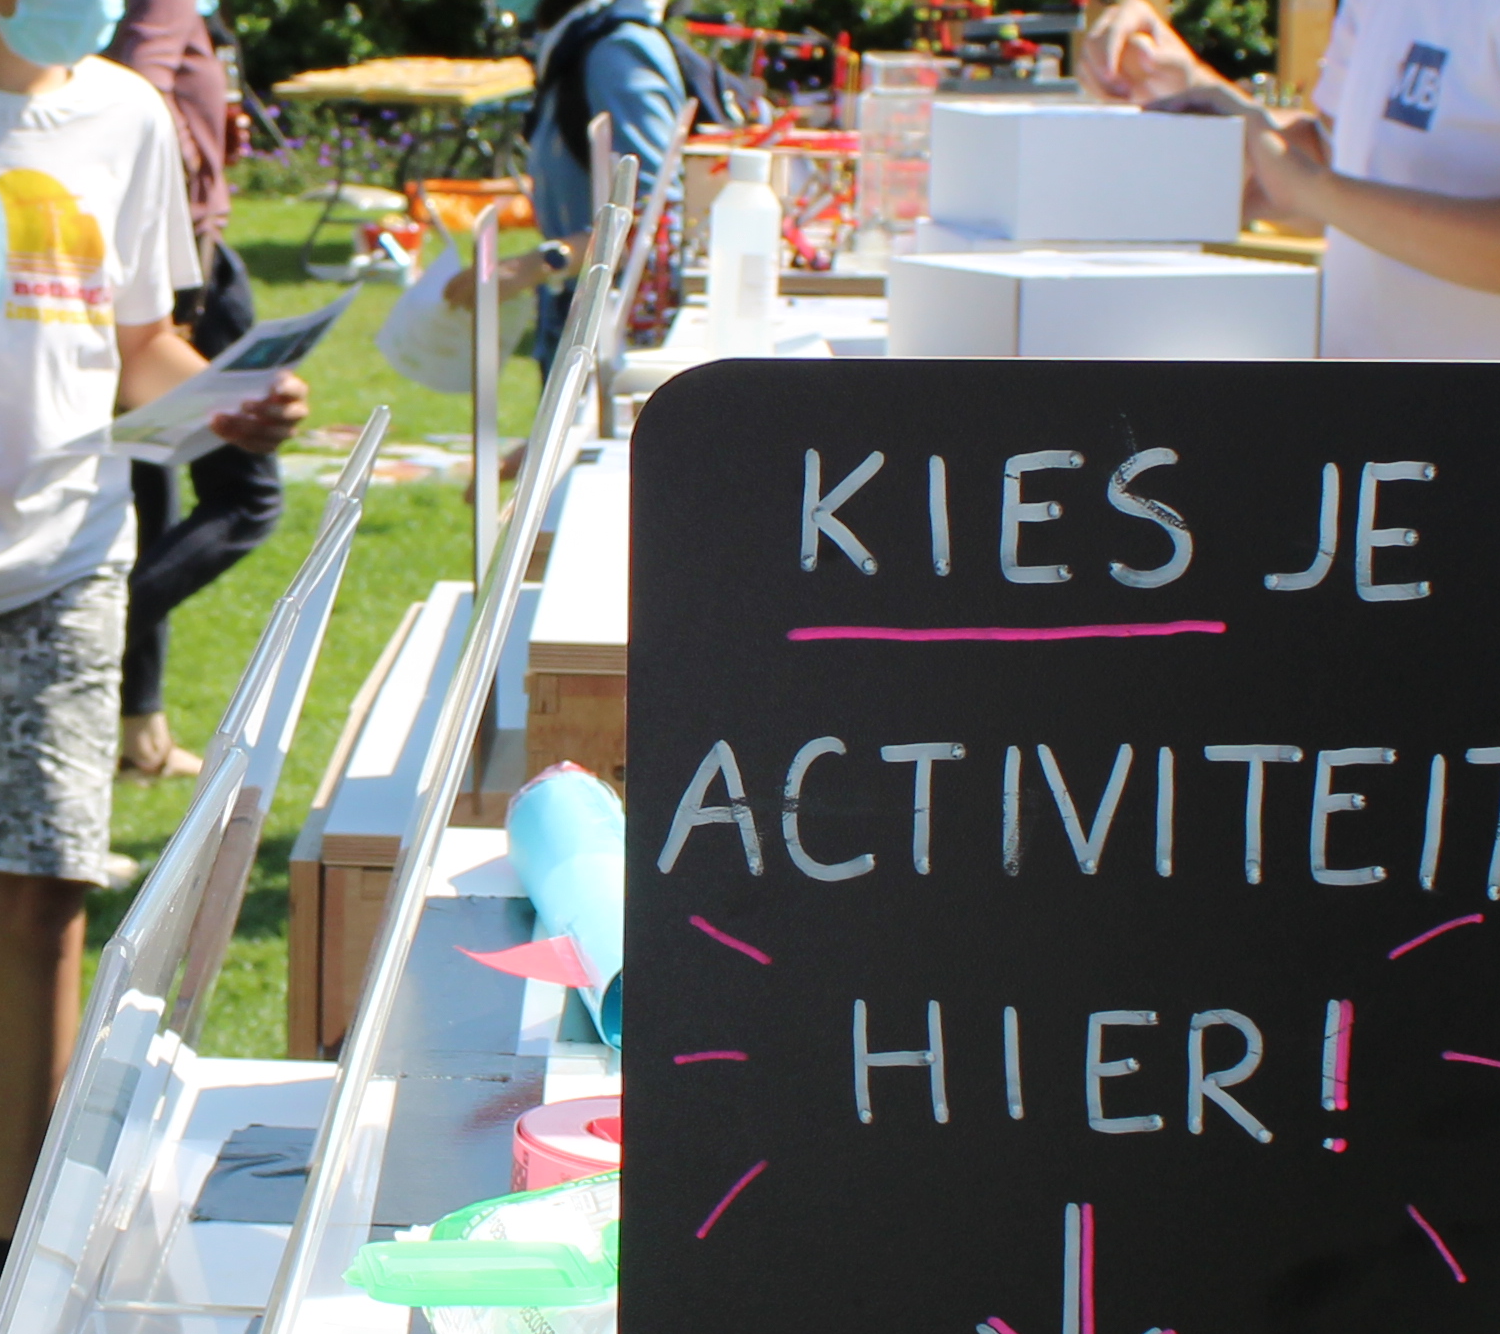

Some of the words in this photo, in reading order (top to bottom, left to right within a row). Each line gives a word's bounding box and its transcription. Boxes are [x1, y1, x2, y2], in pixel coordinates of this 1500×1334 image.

[801, 447, 1194, 590] KIES
[1264, 461, 1437, 603] JE
[853, 999, 1355, 1152] HIER!
